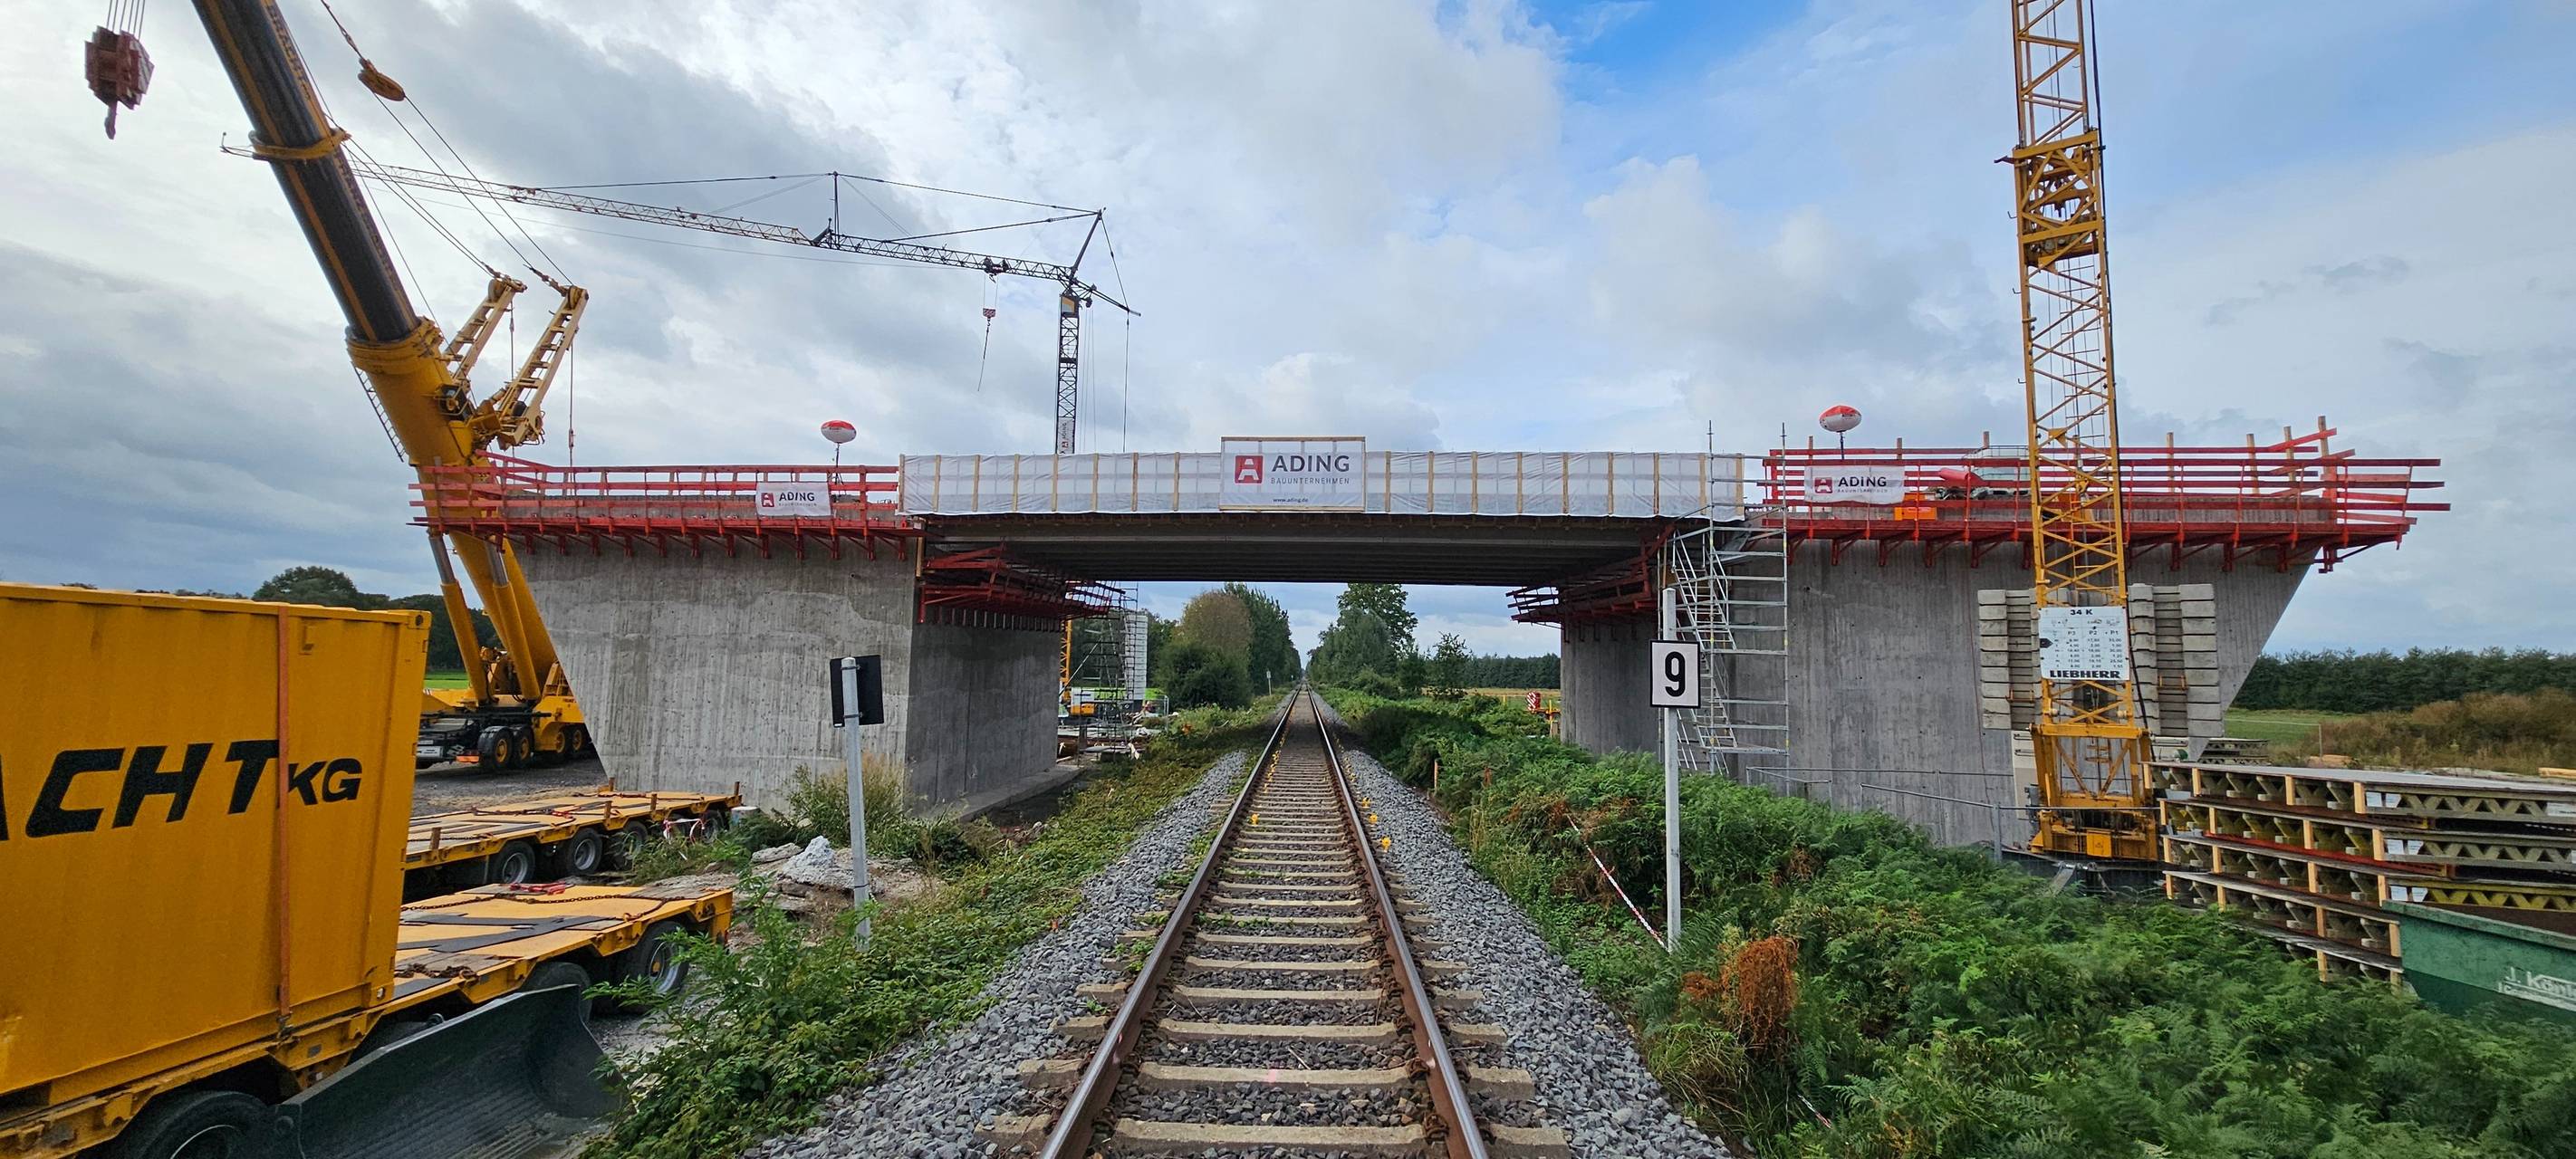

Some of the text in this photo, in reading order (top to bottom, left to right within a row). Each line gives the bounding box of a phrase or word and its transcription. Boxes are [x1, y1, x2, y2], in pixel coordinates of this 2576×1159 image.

[1271, 455, 1350, 473] ADING
[1838, 476, 1888, 487] ADING
[779, 492, 815, 502] ADING
[1665, 651, 1686, 696] 9
[2050, 670, 2120, 678] LIEBHERR
[287, 758, 362, 806] KG
